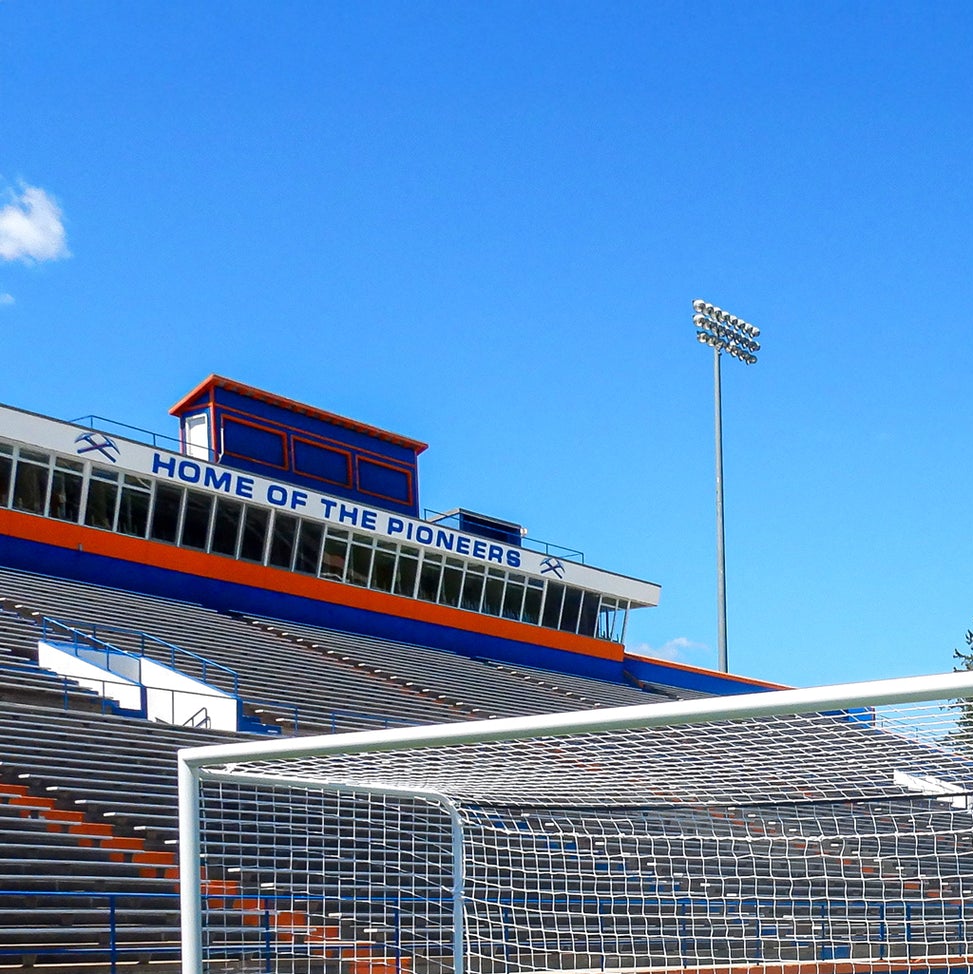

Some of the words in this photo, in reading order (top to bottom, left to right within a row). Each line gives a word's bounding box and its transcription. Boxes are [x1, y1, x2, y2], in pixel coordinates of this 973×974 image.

[152, 453, 254, 498] HOME
[267, 485, 308, 509] OF
[321, 498, 377, 530] THE
[387, 517, 520, 567] PIONEERS
